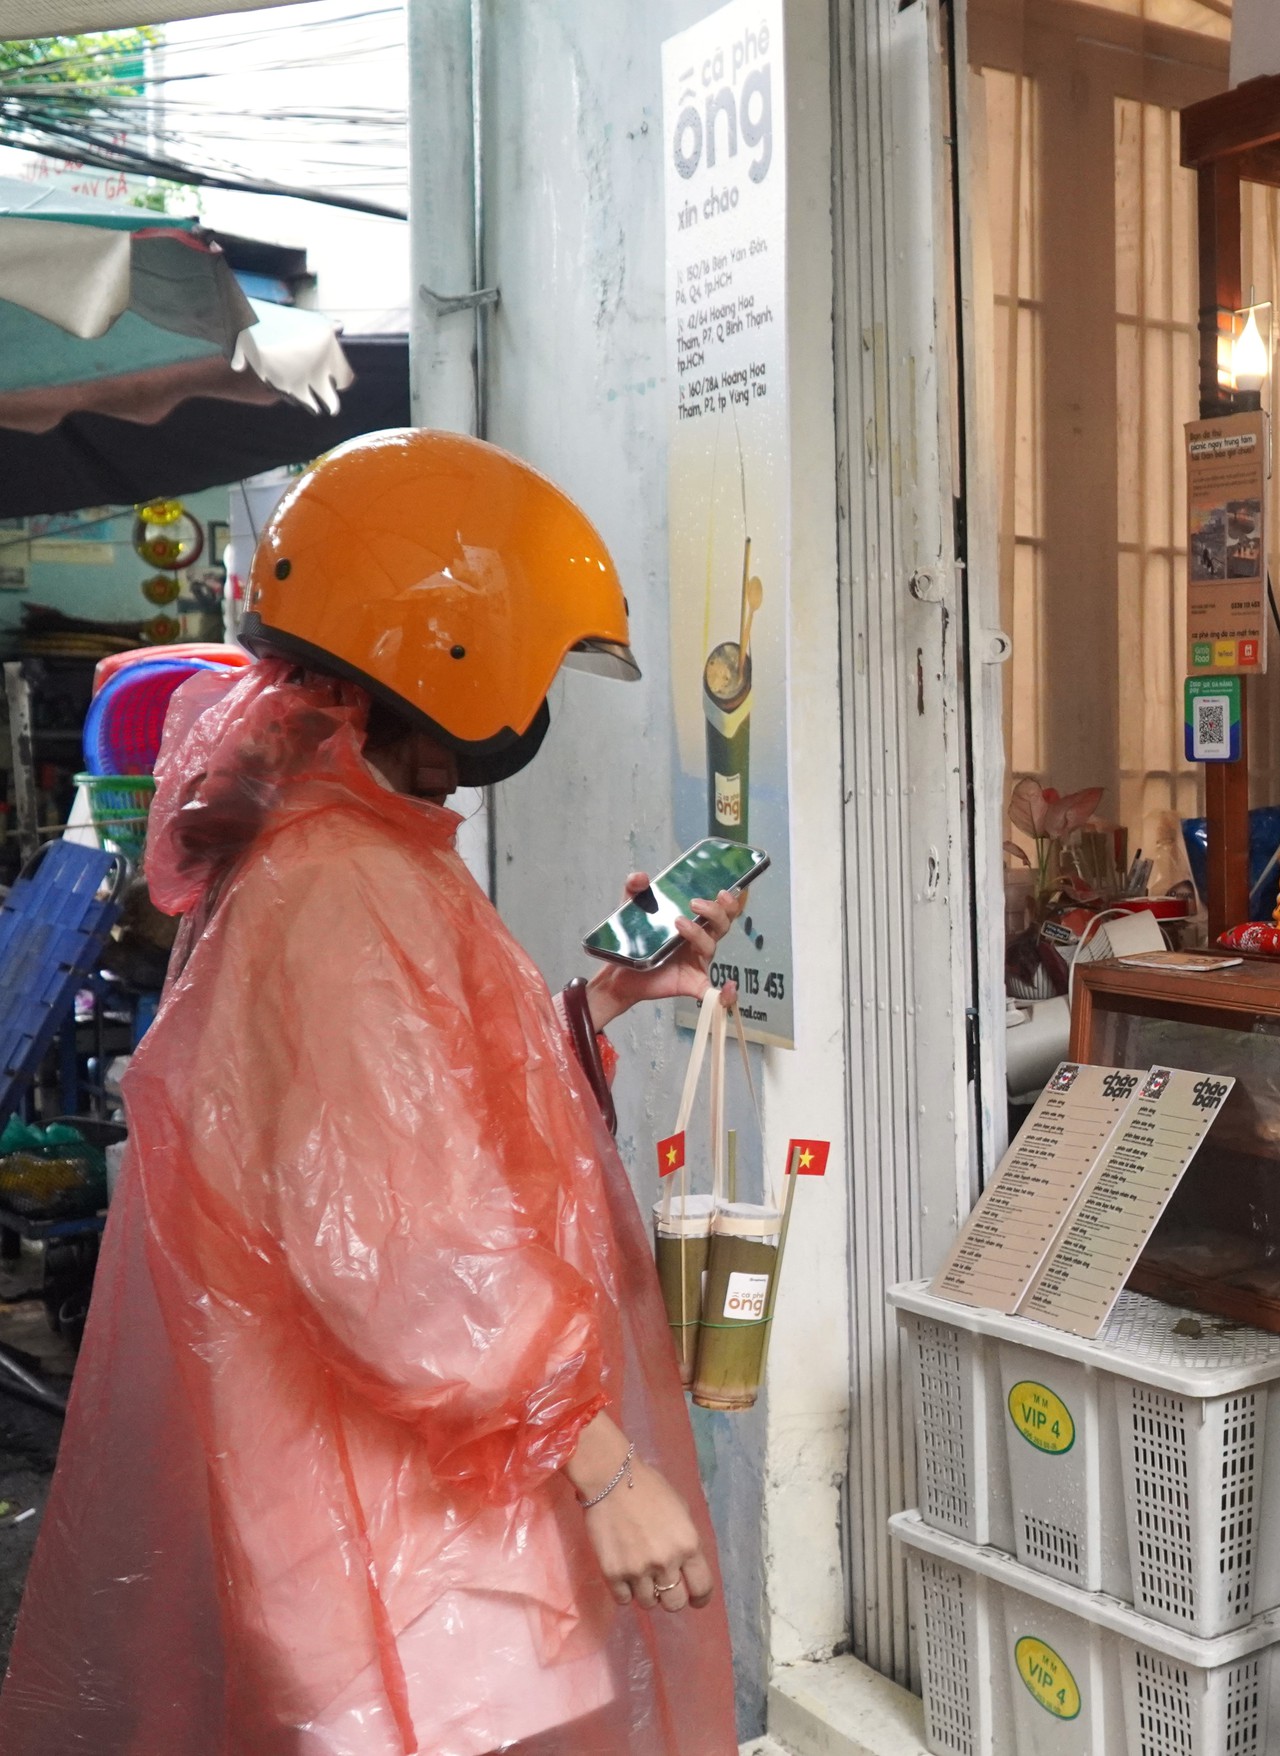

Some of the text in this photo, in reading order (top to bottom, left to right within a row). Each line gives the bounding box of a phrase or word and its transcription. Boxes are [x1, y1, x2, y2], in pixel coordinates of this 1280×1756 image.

[732, 19, 769, 85] phê
[673, 62, 772, 184] ống
[677, 186, 739, 232] xin chào
[738, 294, 754, 311] Hoa
[717, 324, 724, 344] Q
[689, 376, 719, 398] 160/28A
[750, 362, 766, 379] Hoa
[718, 393, 726, 413] tp
[744, 967, 759, 995] 113
[764, 972, 784, 1000] 453
[1103, 1071, 1138, 1088] chào
[1193, 1077, 1228, 1096] chào
[1102, 1086, 1131, 1102] bạn
[1192, 1093, 1221, 1112] bạn
[1022, 1403, 1046, 1429] VIP
[1052, 1421, 1060, 1439] 4
[1029, 1656, 1053, 1688] VIP
[1057, 1688, 1065, 1705] 4
